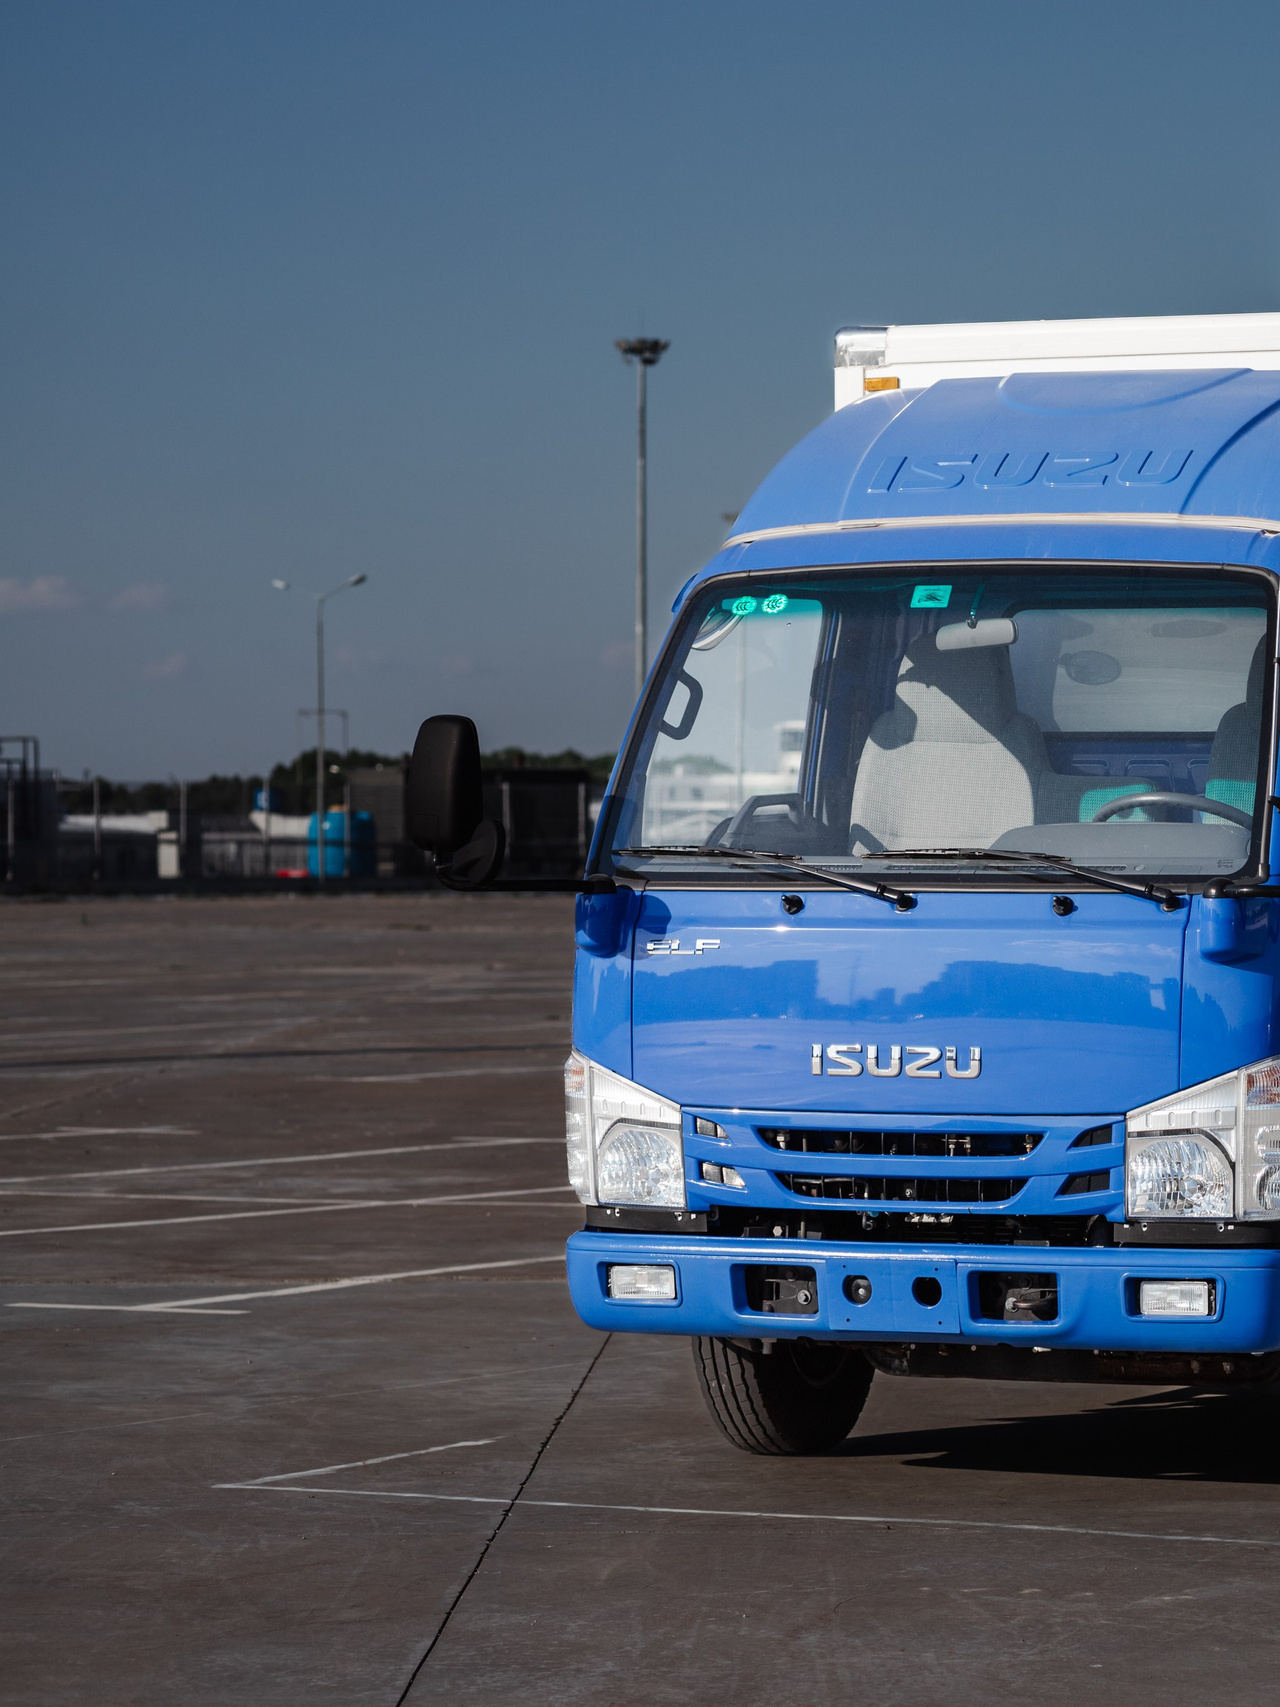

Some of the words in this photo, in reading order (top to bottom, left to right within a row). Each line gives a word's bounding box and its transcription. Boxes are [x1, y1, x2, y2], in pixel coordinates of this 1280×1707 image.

[866, 449, 1195, 493] ISUZU
[646, 938, 721, 955] ELF
[811, 1043, 982, 1079] ISUZU
